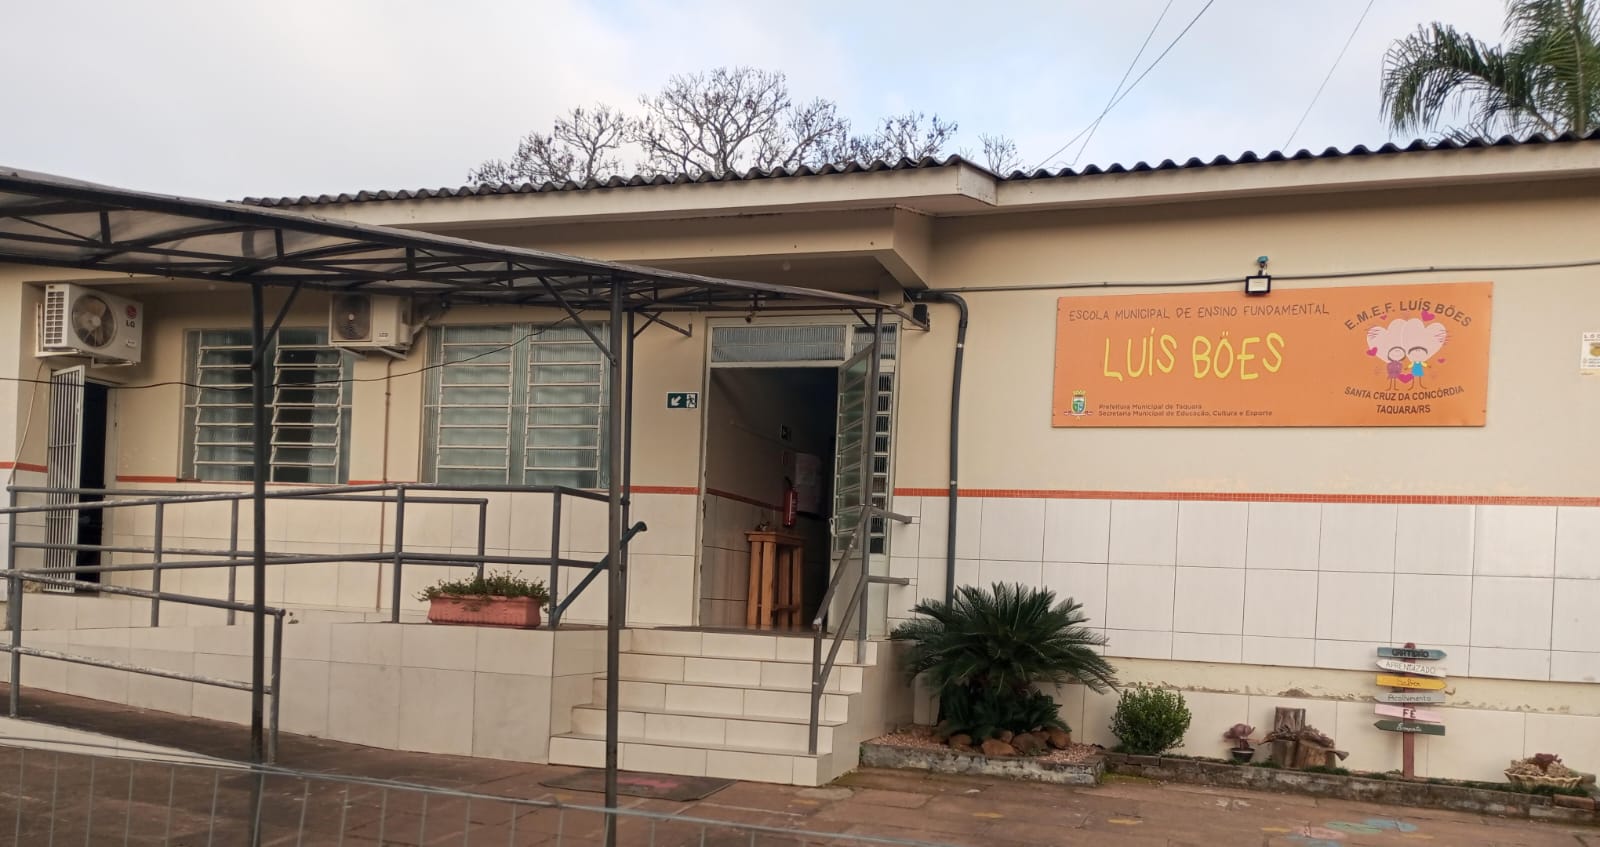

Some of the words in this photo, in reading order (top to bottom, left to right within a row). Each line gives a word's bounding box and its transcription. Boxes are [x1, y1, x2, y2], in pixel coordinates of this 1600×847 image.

[1069, 310, 1109, 321] ESCOLA
[1114, 308, 1169, 320] MUNICIPAL
[1176, 307, 1192, 318] DE
[1198, 306, 1238, 318] ENSINO
[1243, 303, 1330, 316] FUNDAMENTAL
[1344, 302, 1395, 330] E.M.E.F.
[1399, 297, 1431, 312] LUÍS
[1434, 303, 1472, 327] BÖES
[126, 320, 136, 328] LG
[1103, 327, 1178, 381] LUÍS
[1192, 331, 1285, 380] BÖES
[1344, 385, 1371, 399] SANTA
[1373, 391, 1396, 401] CRUZ
[1398, 392, 1411, 401] DA
[1412, 385, 1464, 401] CONCÓRDIA
[1132, 403, 1163, 411] Municipal
[1376, 404, 1431, 414] TAQUARA/RS
[1245, 410, 1273, 418] Esporte
